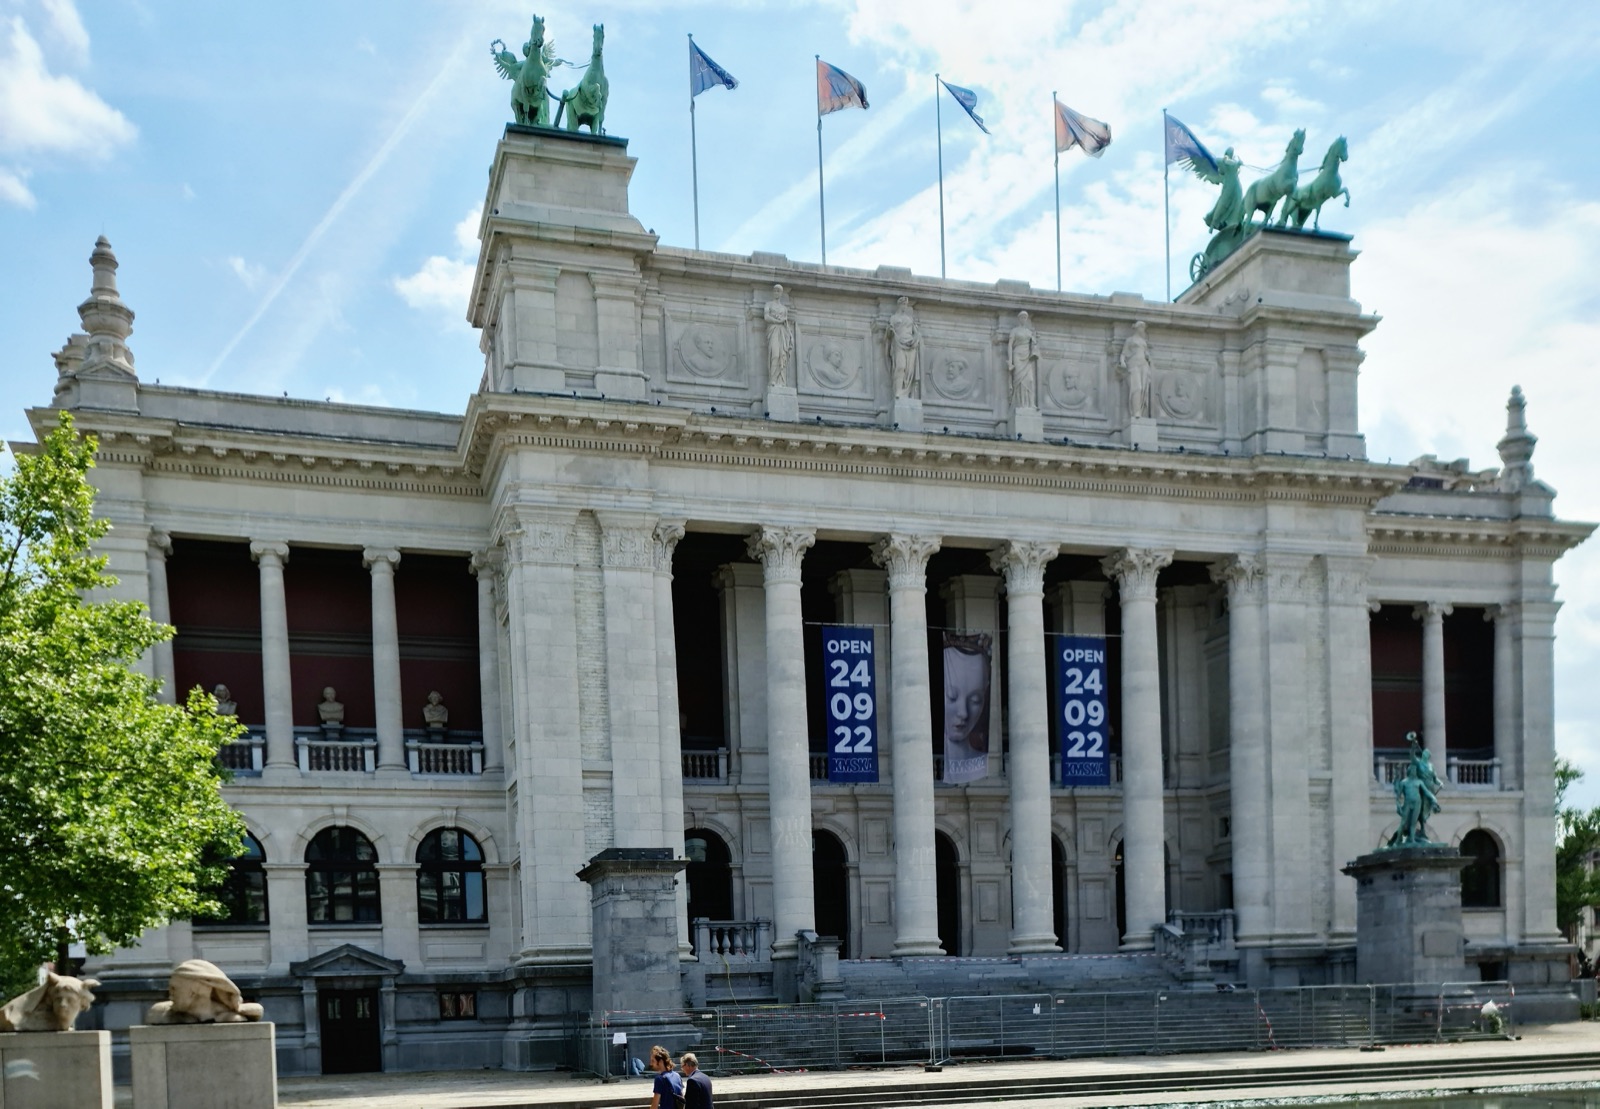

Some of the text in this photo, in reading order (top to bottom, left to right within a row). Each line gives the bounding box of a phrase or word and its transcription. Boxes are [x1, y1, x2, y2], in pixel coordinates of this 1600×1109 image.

[827, 640, 872, 654] OPEN
[1063, 649, 1104, 663] OPEN
[830, 659, 871, 687] 24
[1065, 667, 1103, 695] 24
[831, 692, 873, 720] 09
[1064, 699, 1105, 727] 09
[834, 725, 872, 753] 22
[1067, 731, 1104, 758] 22
[832, 757, 876, 773] KMSKA
[1065, 762, 1107, 777] KMSKA
